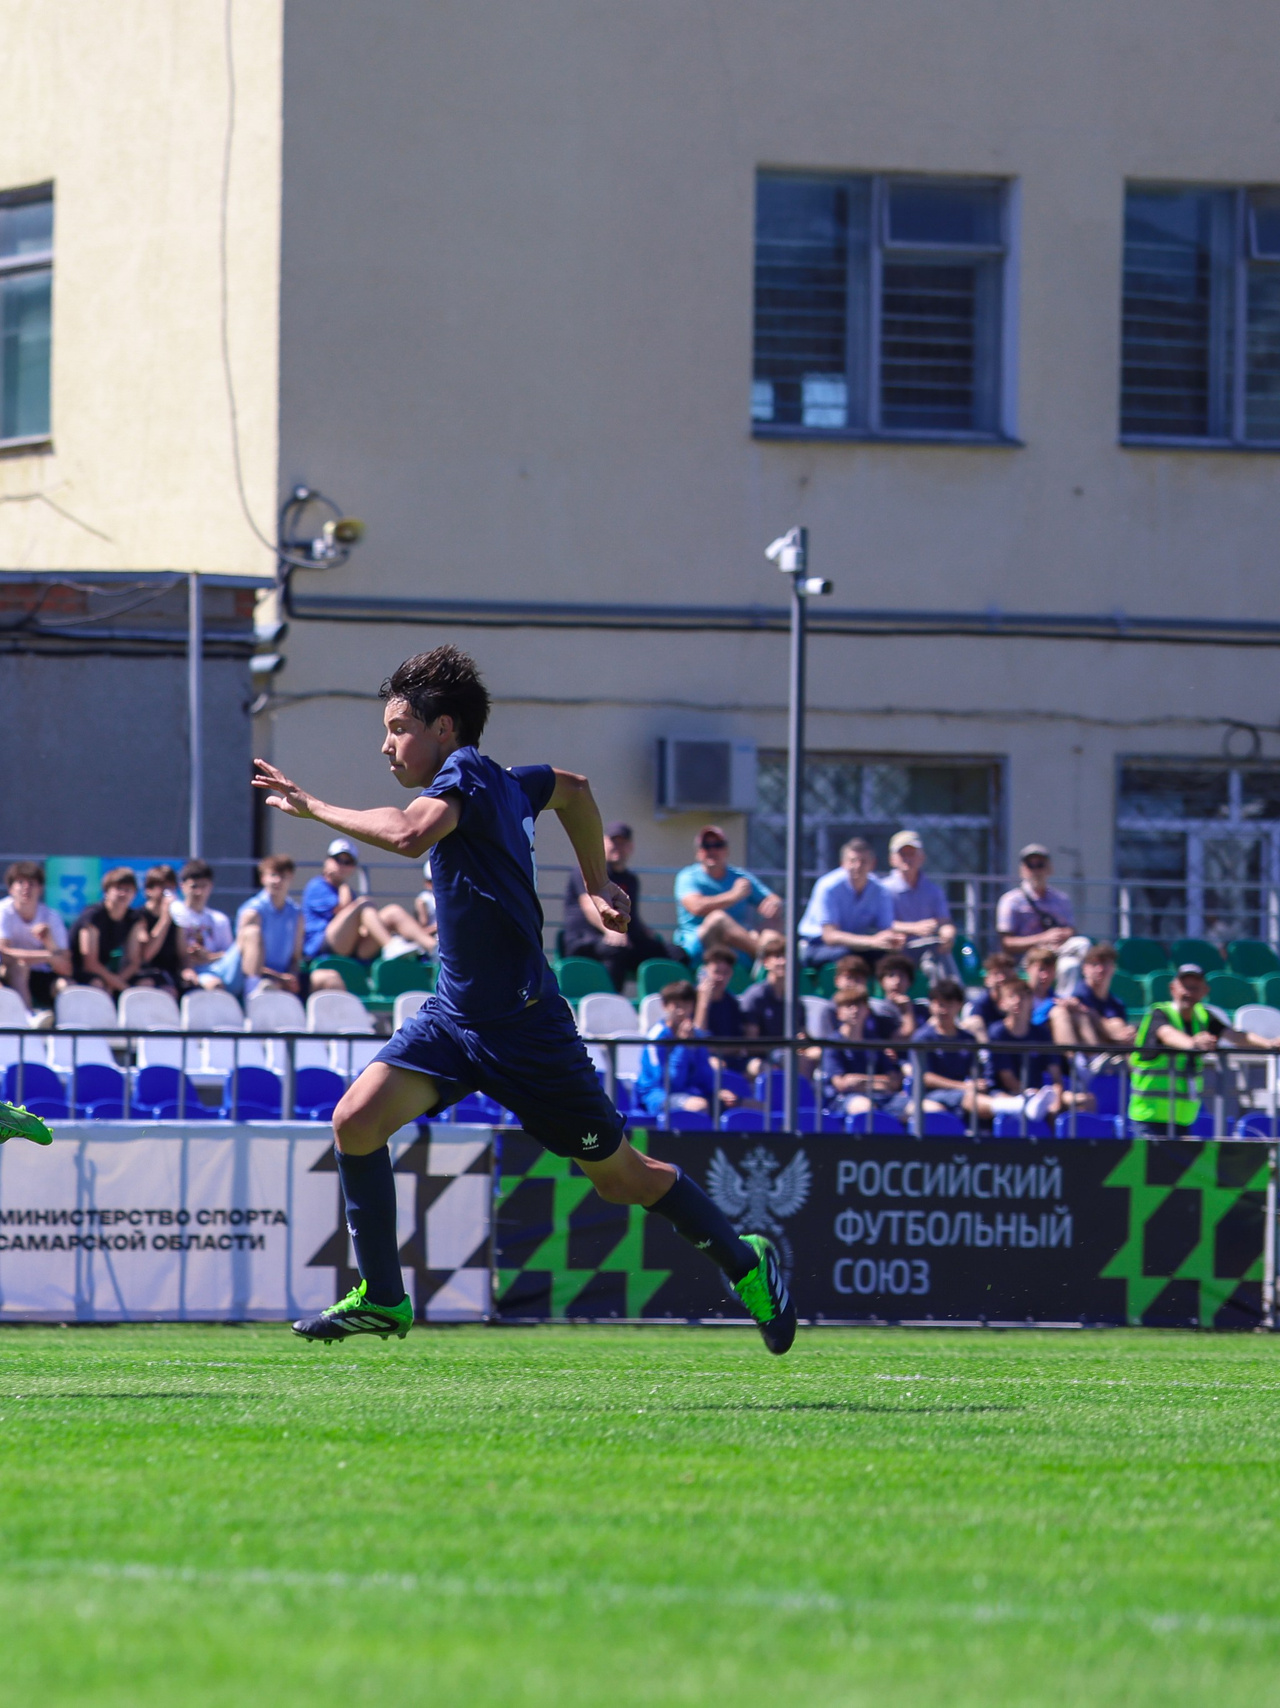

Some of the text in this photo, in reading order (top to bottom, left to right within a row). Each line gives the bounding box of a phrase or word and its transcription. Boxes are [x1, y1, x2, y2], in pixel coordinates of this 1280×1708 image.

[60, 875, 87, 914] 3
[837, 1154, 1063, 1199] РОССИЙСКИЙ
[196, 1209, 288, 1226] СПОРТА
[834, 1205, 1073, 1249] ФУТБОЛЬНЫЙ
[152, 1234, 266, 1251] ОБЛАСТИ
[833, 1257, 931, 1295] СОЮЗ
